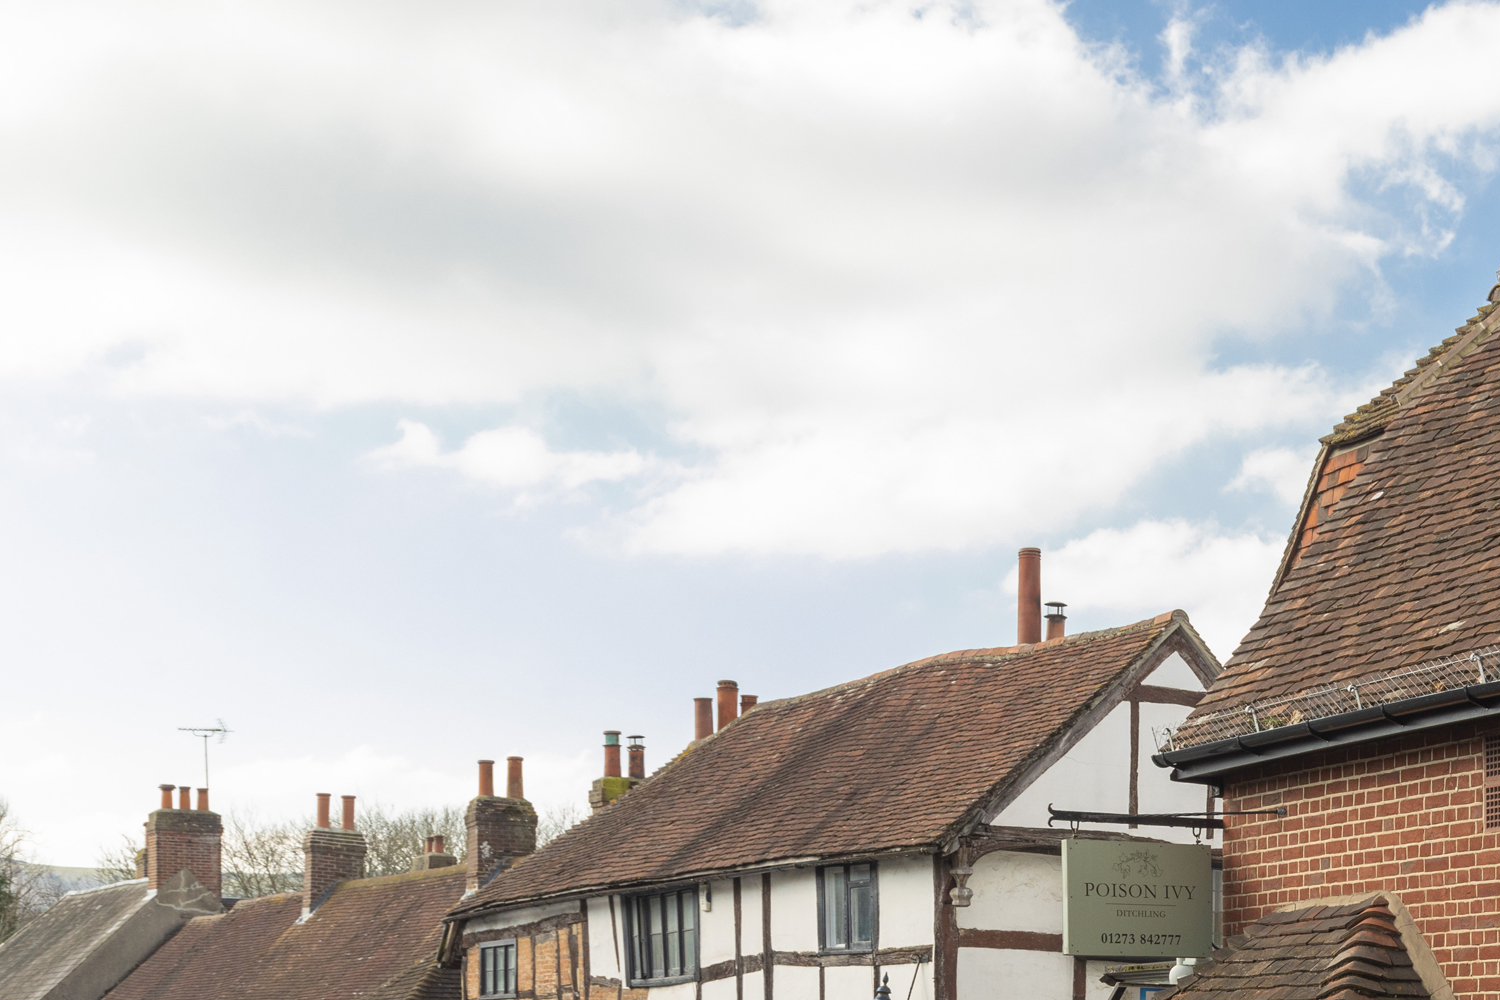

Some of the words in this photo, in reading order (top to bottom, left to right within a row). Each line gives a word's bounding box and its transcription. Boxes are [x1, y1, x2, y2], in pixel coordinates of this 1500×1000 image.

[1085, 882, 1157, 899] POISON
[1164, 885, 1196, 900] IVY
[1116, 909, 1166, 918] DITCHLING
[1101, 933, 1135, 945] 01273
[1140, 934, 1181, 945] 842777
